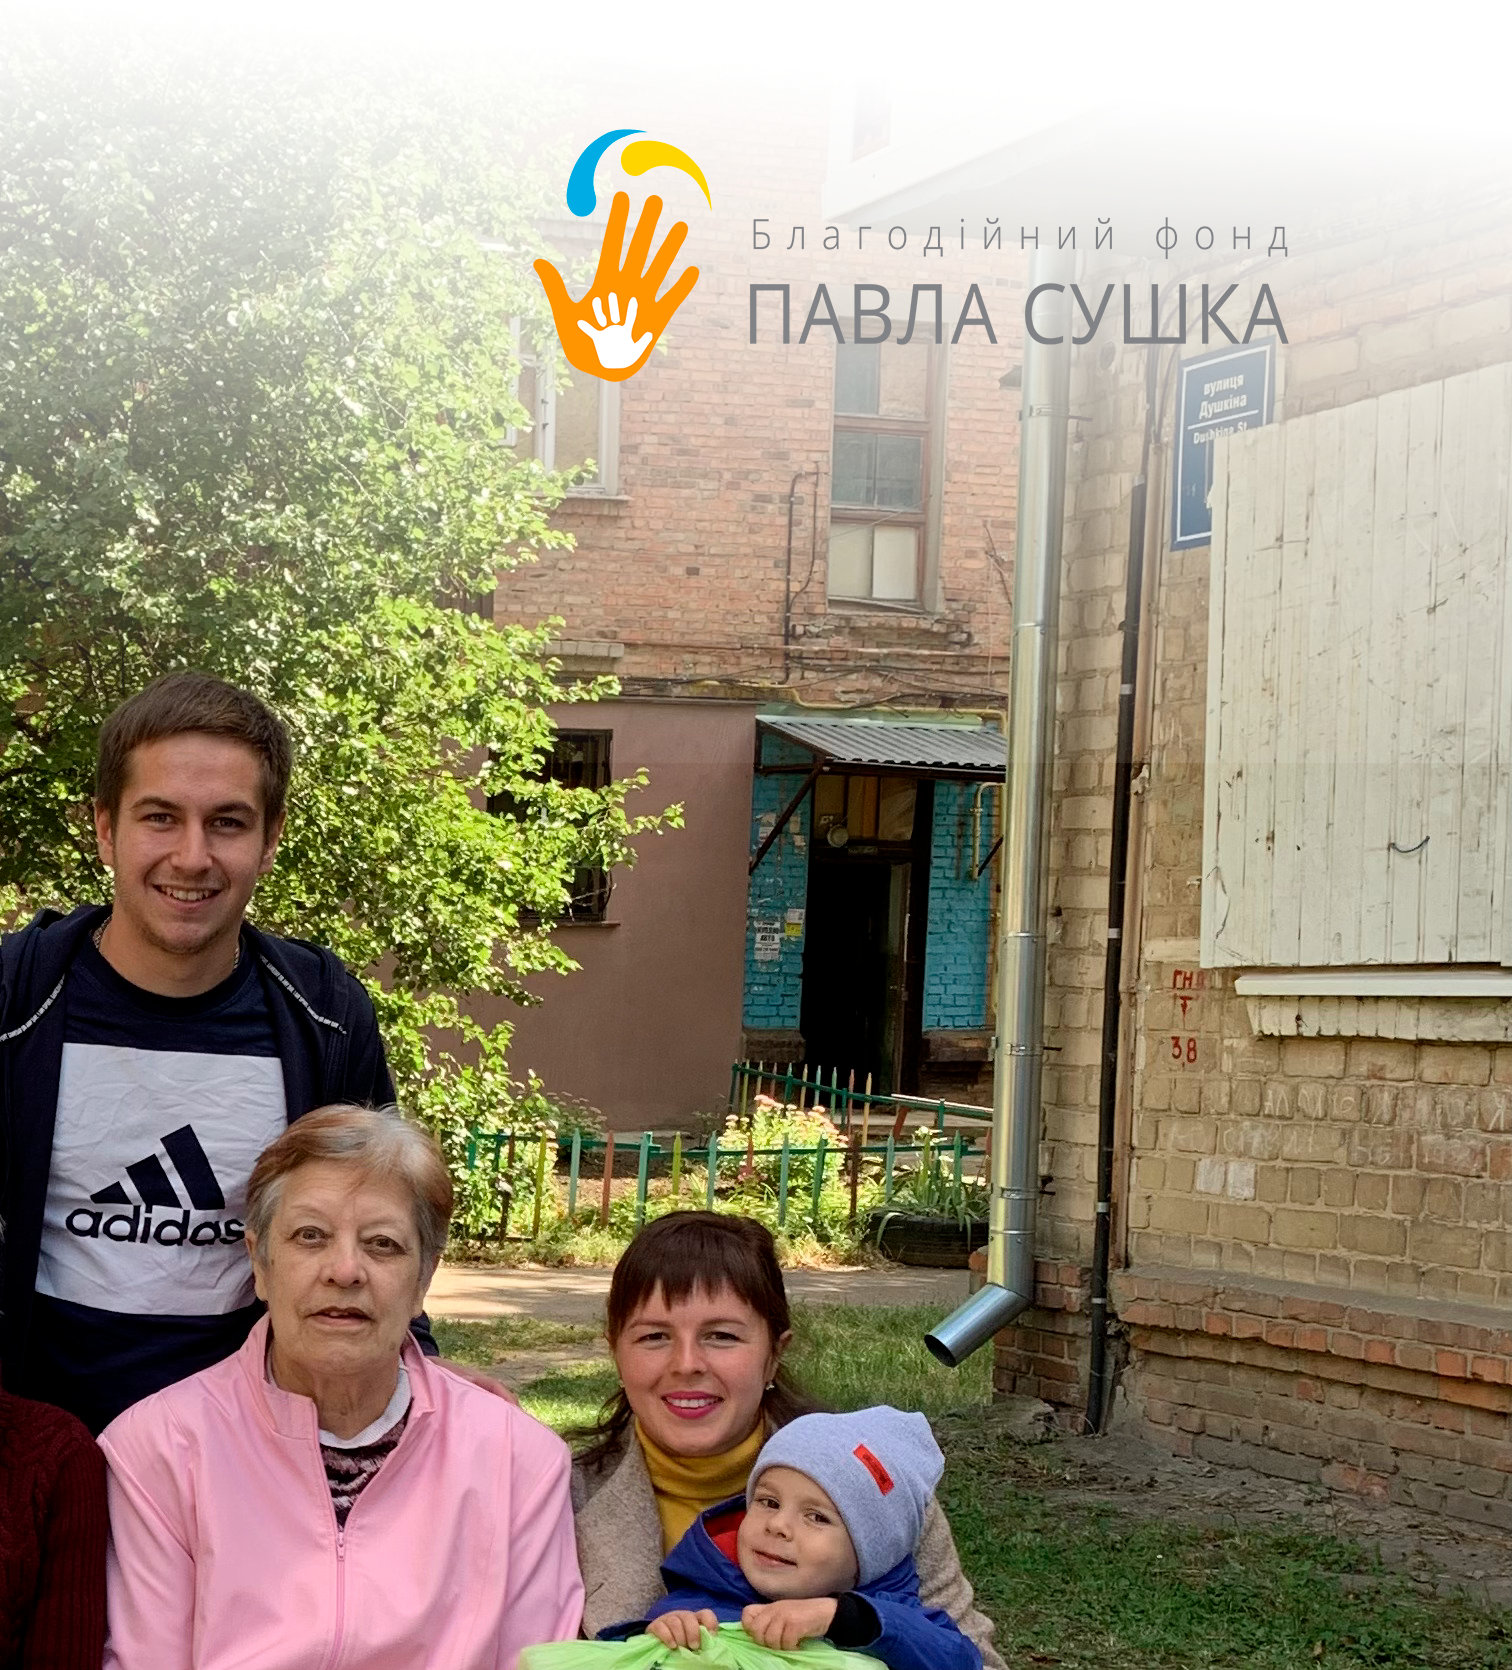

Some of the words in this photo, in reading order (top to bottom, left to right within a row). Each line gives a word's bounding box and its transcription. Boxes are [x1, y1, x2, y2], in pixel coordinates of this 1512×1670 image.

[1203, 374, 1245, 398] вулиця
[1198, 394, 1247, 420] Душкіна
[65, 1204, 245, 1247] adidas
